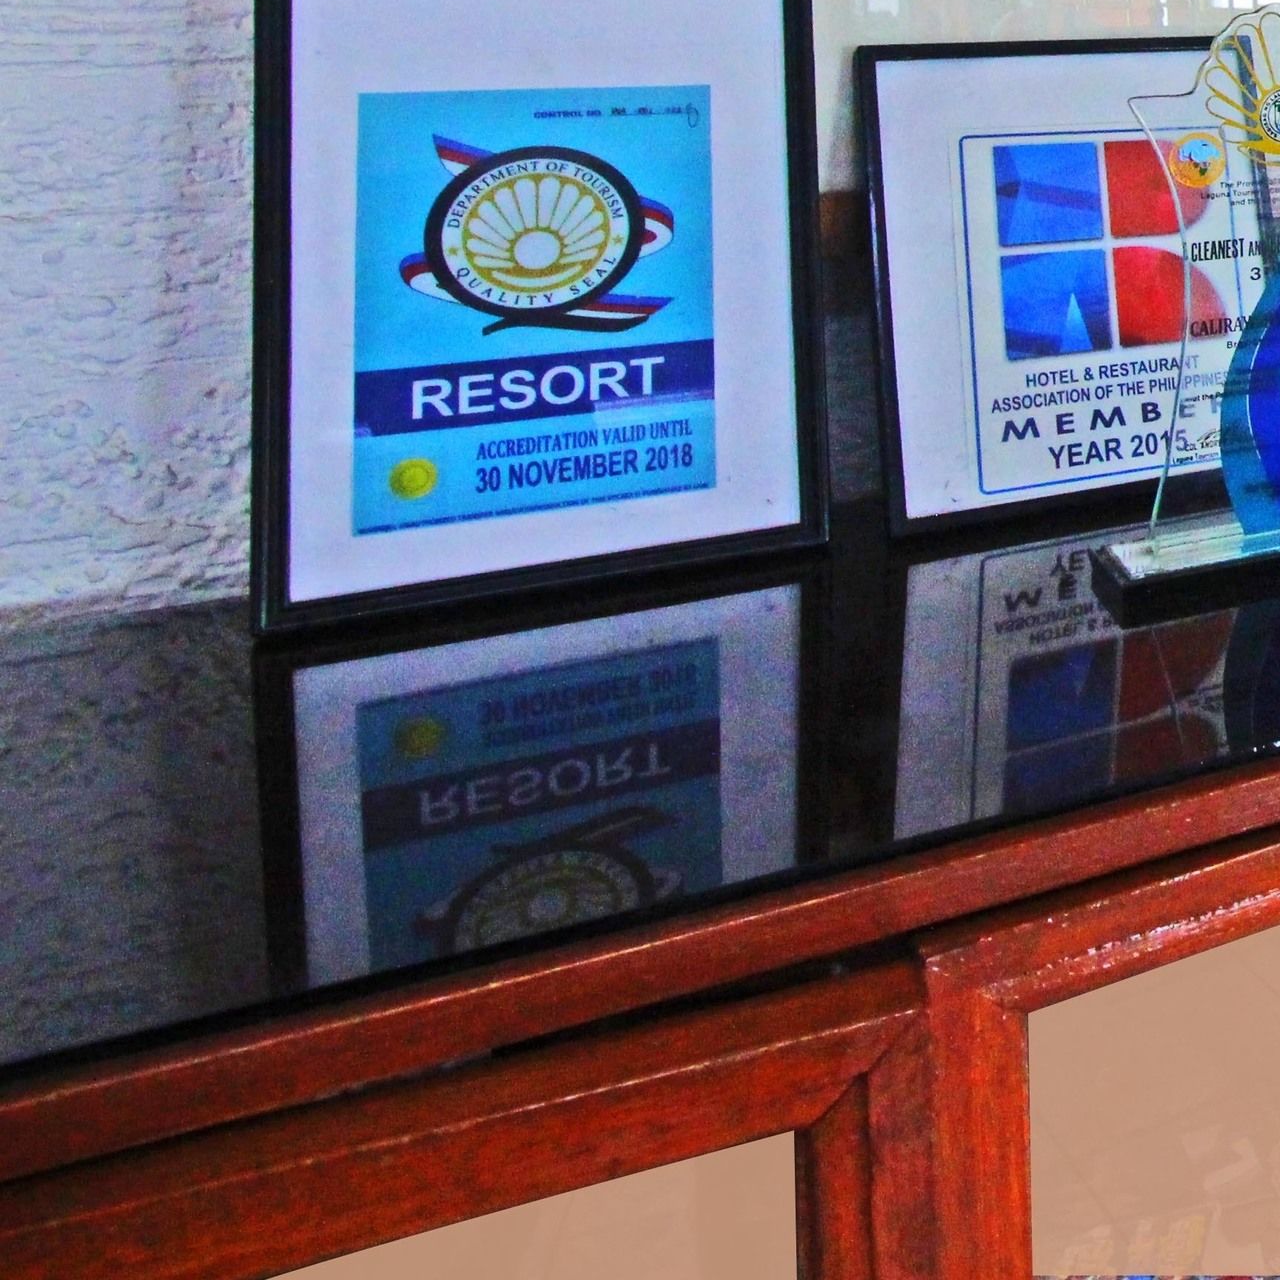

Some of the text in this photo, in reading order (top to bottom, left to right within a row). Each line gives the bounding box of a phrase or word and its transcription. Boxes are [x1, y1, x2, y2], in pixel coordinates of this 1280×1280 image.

[448, 160, 624, 229] DEPARTMENT OF TOURISM
[1191, 238, 1245, 263] CLEANEST
[456, 254, 617, 306] QUALITY SEAL
[411, 356, 666, 420] RESORT
[1025, 368, 1079, 389] HOTEL
[1083, 366, 1095, 381] &
[1098, 355, 1200, 380] RESTAURANT
[991, 387, 1091, 414] ASSOCIATION
[1095, 384, 1113, 400] OF
[1117, 379, 1145, 397] THE
[476, 418, 693, 461] ACCREDITATION VALID UNTIL
[1048, 429, 1187, 470] YEAR 2015
[475, 442, 694, 494] 30 NOVEMBER 2018
